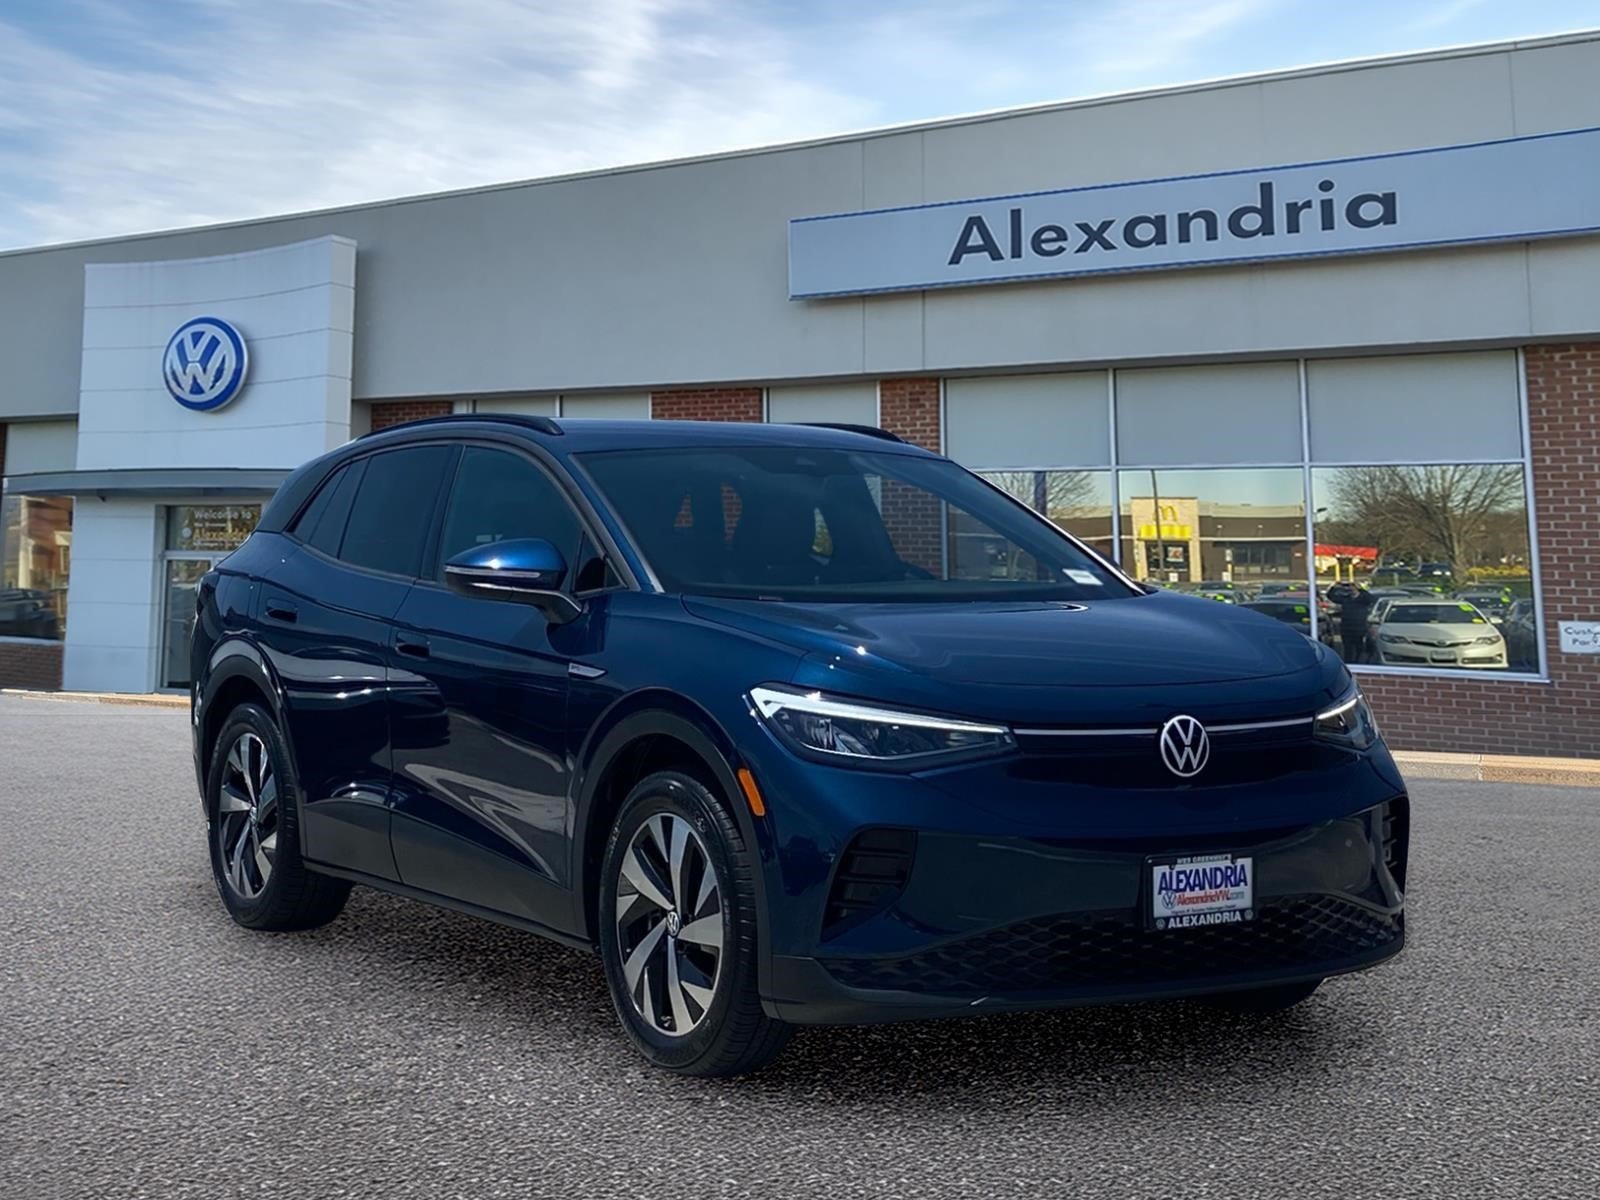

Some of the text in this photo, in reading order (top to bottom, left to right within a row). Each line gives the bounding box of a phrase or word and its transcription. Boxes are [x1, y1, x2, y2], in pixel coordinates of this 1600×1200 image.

[947, 179, 1399, 266] Alexandria
[165, 322, 239, 403] VW
[194, 510, 252, 519] Welcome to
[193, 528, 249, 540] Alexandri
[1161, 715, 1208, 774] VW
[1158, 864, 1248, 895] ALEXANDRIA
[1168, 911, 1242, 929] ALEXANDRIA
